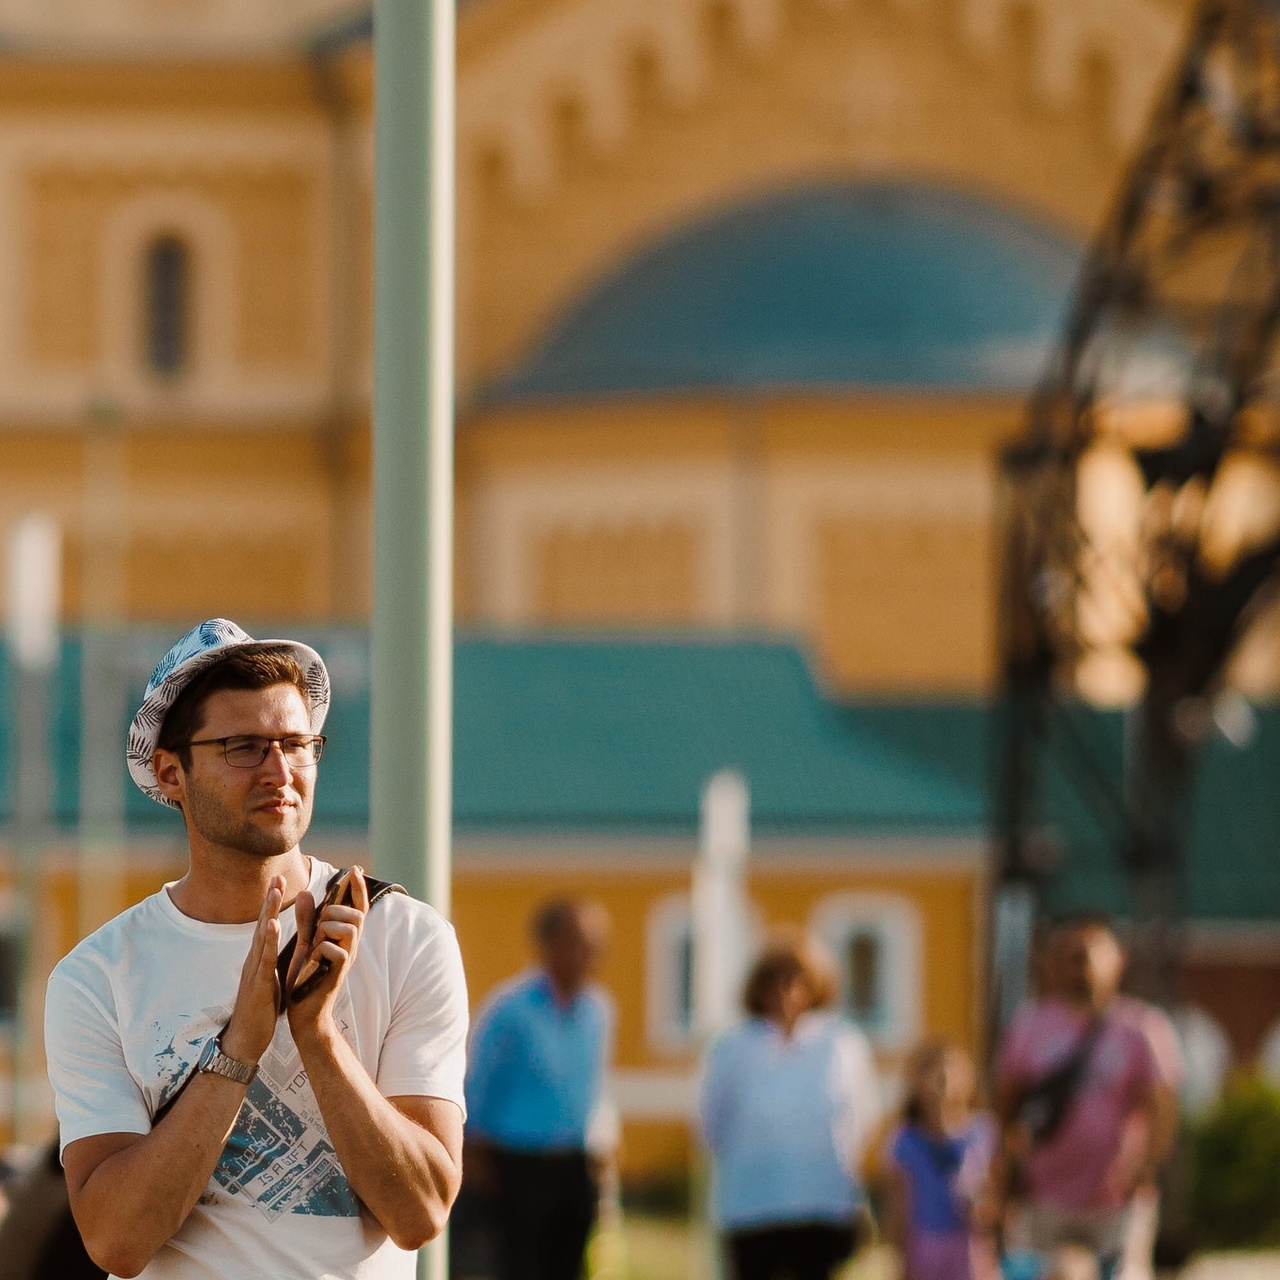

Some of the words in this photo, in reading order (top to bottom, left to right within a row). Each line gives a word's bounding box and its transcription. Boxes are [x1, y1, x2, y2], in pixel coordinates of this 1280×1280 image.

[258, 1173, 274, 1187] IS
[272, 1162, 284, 1176] A
[281, 1140, 308, 1167] GIFT
